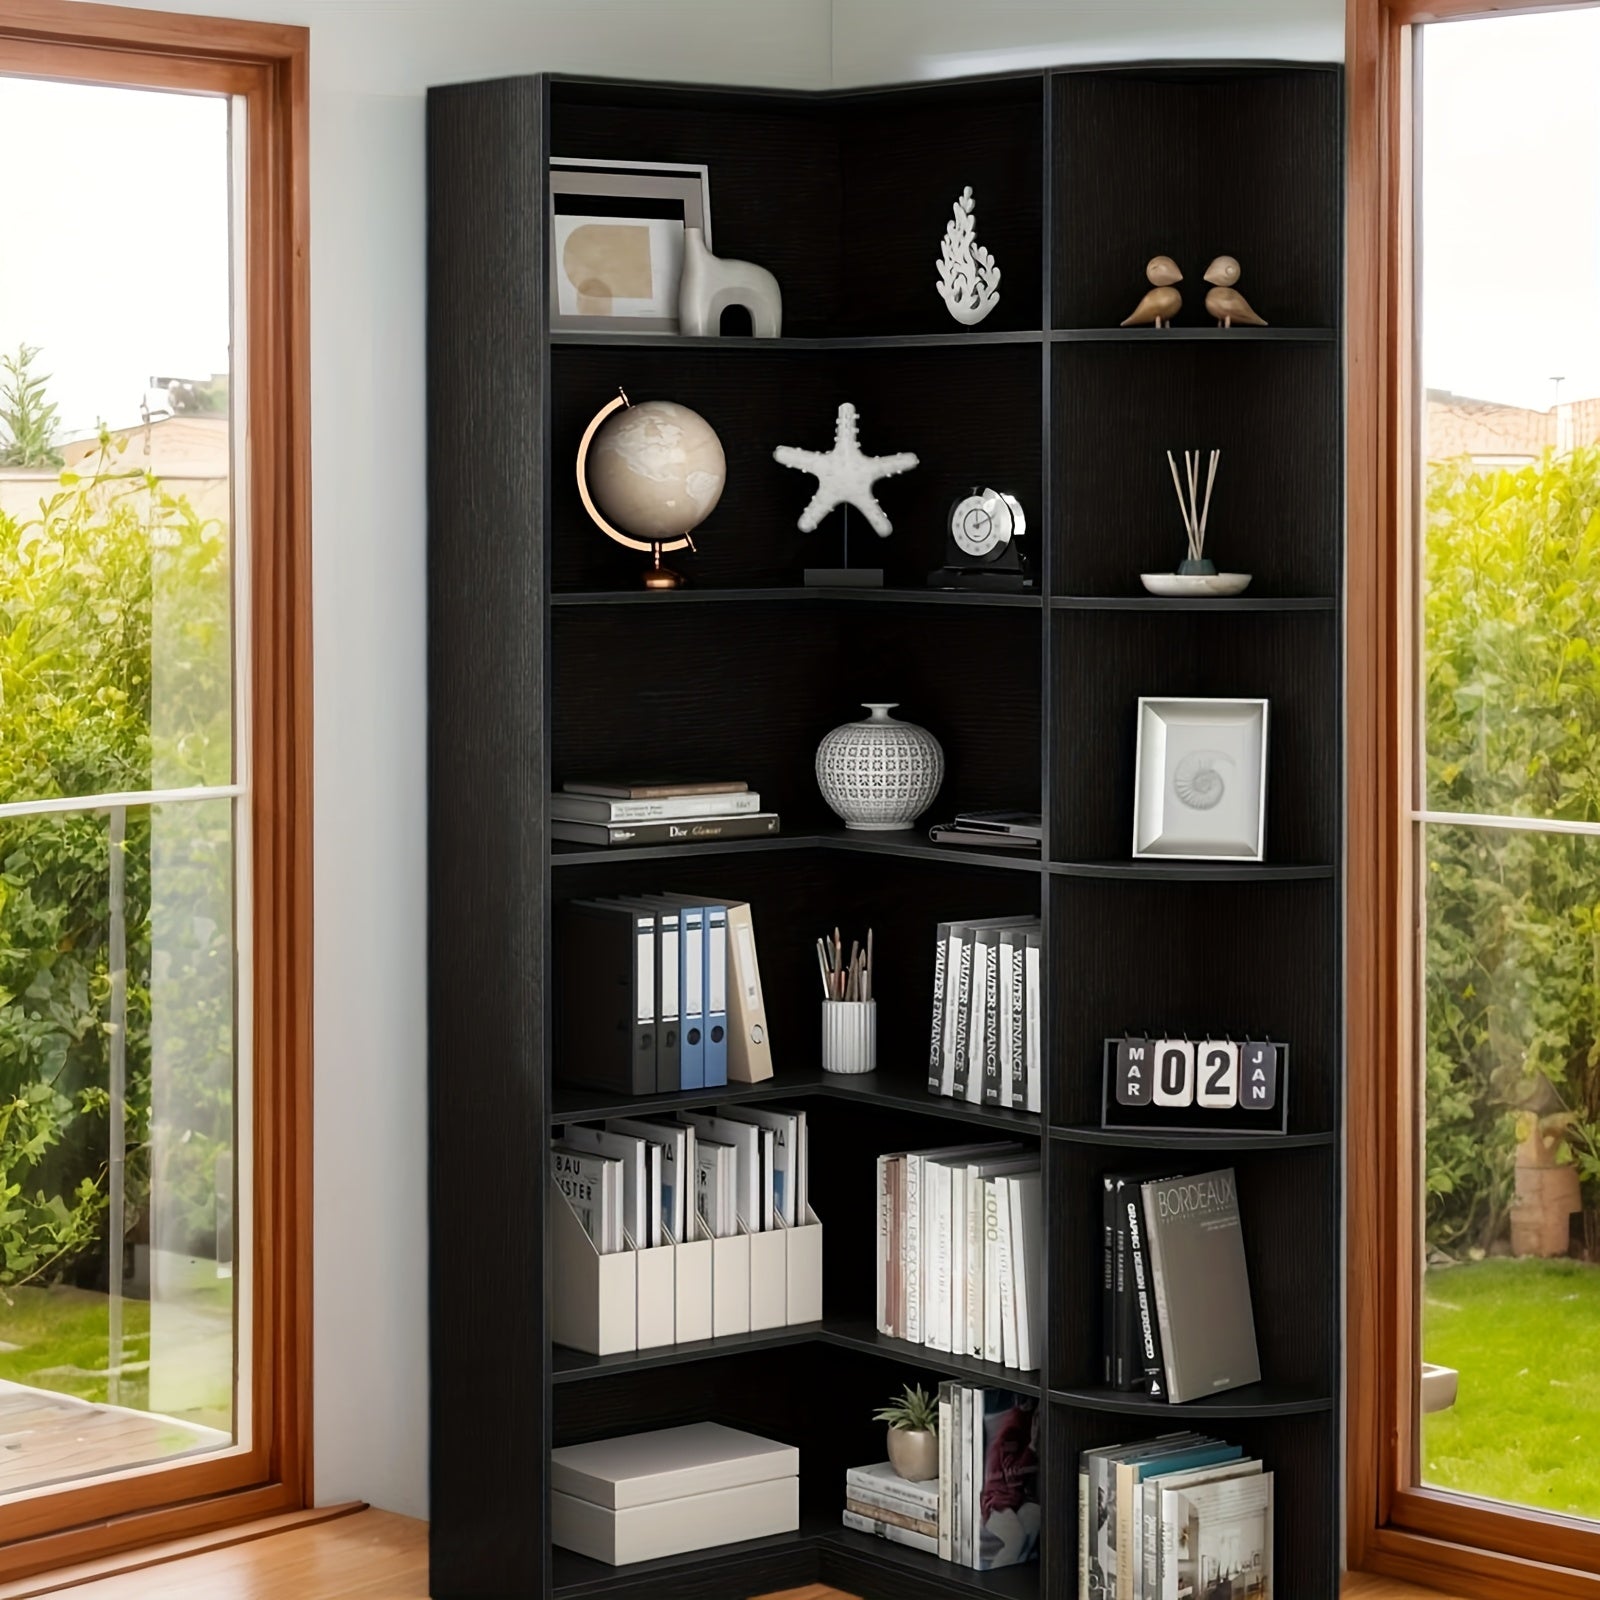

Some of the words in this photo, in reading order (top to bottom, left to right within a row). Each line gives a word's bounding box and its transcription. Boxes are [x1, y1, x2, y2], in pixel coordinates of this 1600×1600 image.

[669, 825, 688, 838] Dior
[1127, 1046, 1145, 1096] MAR
[1161, 1048, 1231, 1096] 02
[1251, 1050, 1266, 1100] JAN
[1158, 1178, 1235, 1218] BORDEAUX
